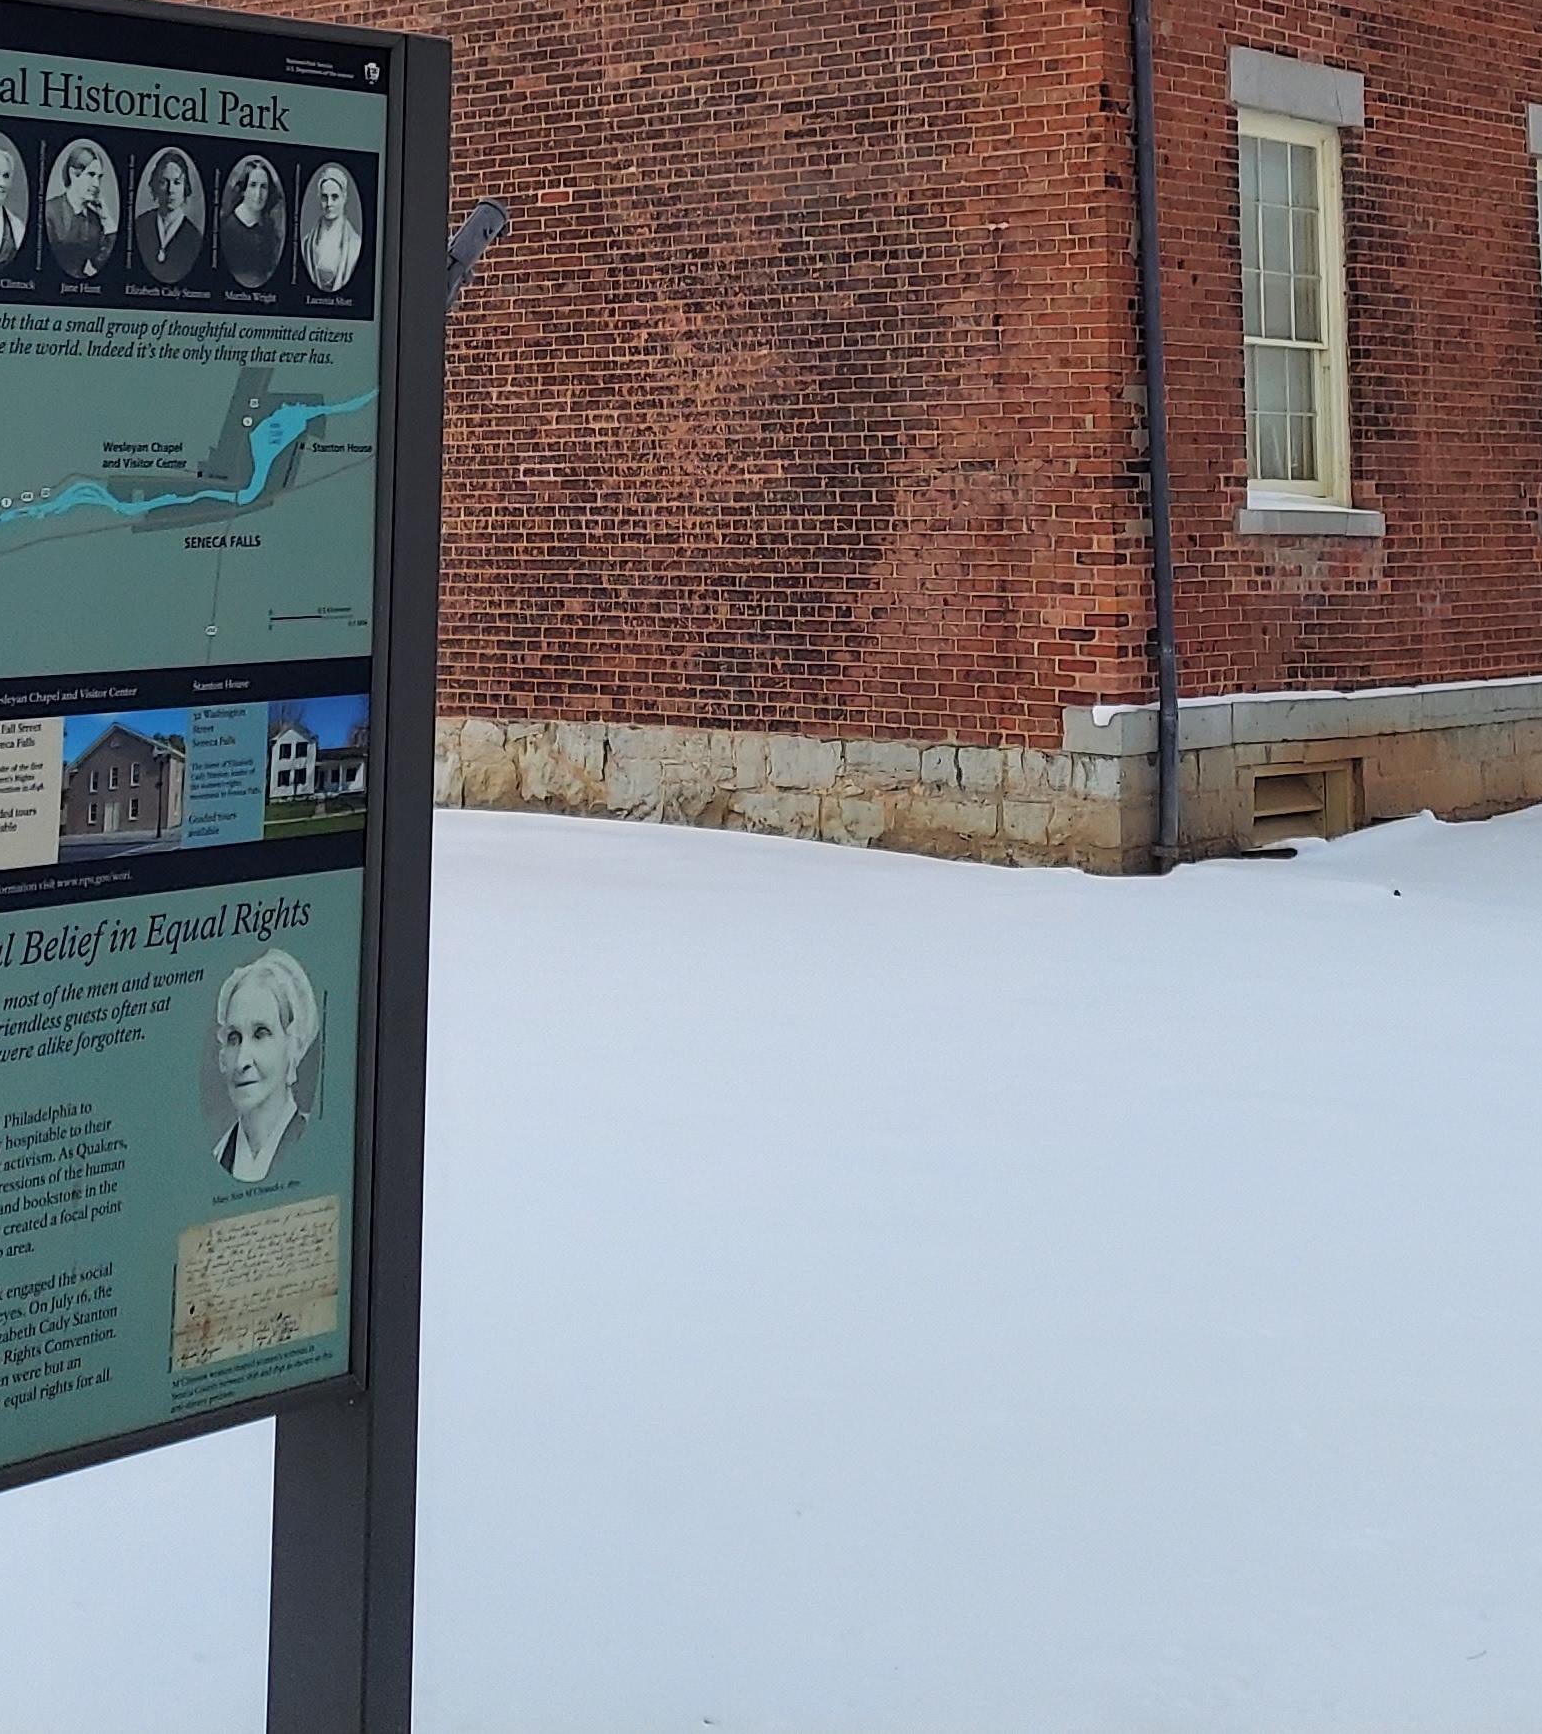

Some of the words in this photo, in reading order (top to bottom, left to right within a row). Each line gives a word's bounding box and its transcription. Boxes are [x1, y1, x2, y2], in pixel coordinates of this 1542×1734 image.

[38, 71, 208, 122] Historical
[217, 91, 295, 131] Park
[19, 313, 50, 330] that
[52, 319, 62, 331] a
[65, 316, 105, 332] small
[105, 322, 148, 339] group
[151, 319, 167, 340] of
[166, 320, 237, 341] thoughtful
[238, 325, 307, 340] committed
[308, 327, 353, 342] citizens
[9, 337, 32, 354] the
[35, 339, 82, 355] world.
[87, 340, 135, 357] Indeed
[136, 342, 156, 358] it's
[158, 342, 180, 359] the
[182, 344, 212, 364] only
[213, 344, 248, 366] thing
[249, 346, 277, 362] that
[278, 351, 307, 362] ever
[308, 348, 333, 364] has.
[102, 441, 149, 454] Wesleyan
[150, 442, 183, 454] Chapel
[312, 442, 345, 452] Stanton
[347, 443, 373, 452] House
[101, 457, 121, 468] and
[122, 457, 154, 468] Visitor
[155, 457, 187, 468] Center
[184, 535, 227, 548] SENECA
[229, 535, 261, 547] FALLS
[192, 680, 223, 690] Stanton
[224, 679, 249, 688] House
[28, 690, 59, 704] Chapel
[61, 689, 78, 700] and
[79, 688, 107, 698] Visitor
[108, 687, 137, 696] Center
[19, 920, 107, 965] Belief
[109, 927, 137, 952] in
[145, 905, 227, 953] Equal
[231, 897, 311, 941] Rights
[37, 1035, 73, 1056] alike
[73, 1028, 145, 1055] forgotten.
[3, 1104, 77, 1128] Philadelphia
[80, 1103, 92, 1114] to
